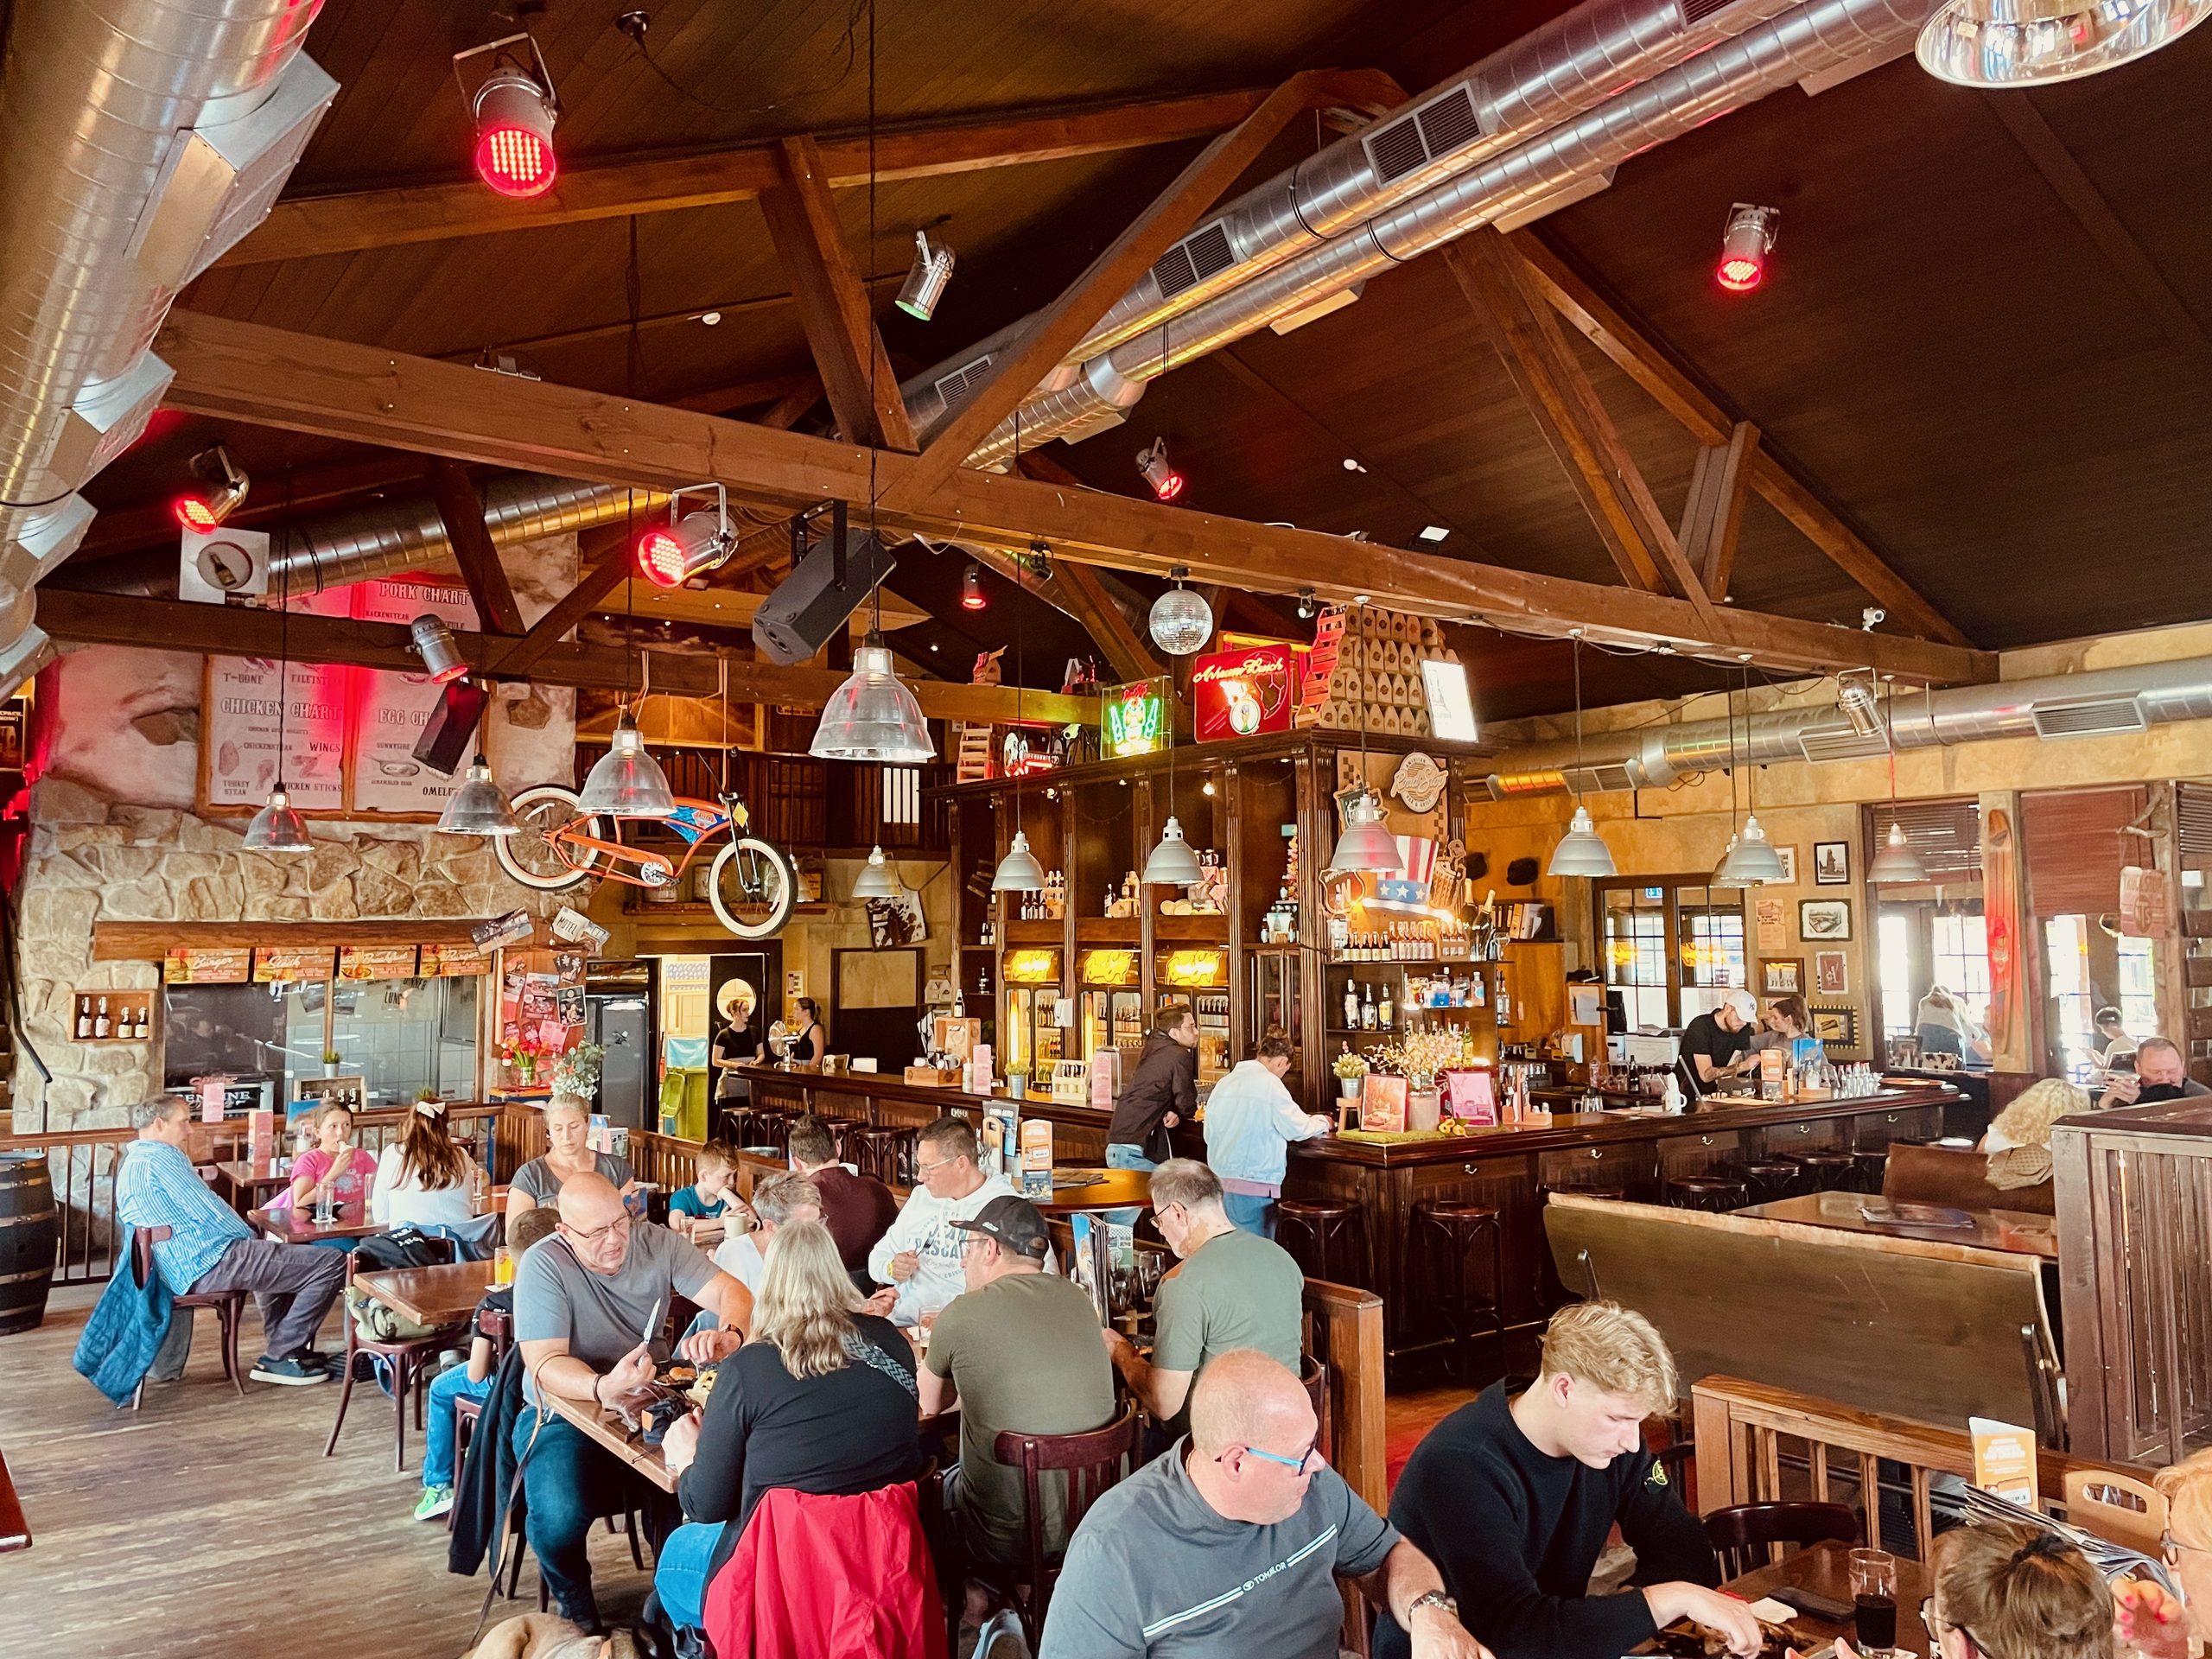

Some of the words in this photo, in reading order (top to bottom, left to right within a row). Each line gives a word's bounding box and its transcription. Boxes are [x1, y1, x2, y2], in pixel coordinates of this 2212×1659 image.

[380, 581, 417, 600] PORK
[423, 588, 470, 606] CHART
[223, 671, 264, 685] T-BONE
[221, 696, 284, 717] CHICKEN
[290, 702, 343, 721] CHART
[378, 708, 405, 726] EGG
[309, 741, 340, 753] WINGS
[314, 783, 342, 792] STICKS
[557, 915, 579, 936] MOTEL
[192, 954, 234, 971] Burger
